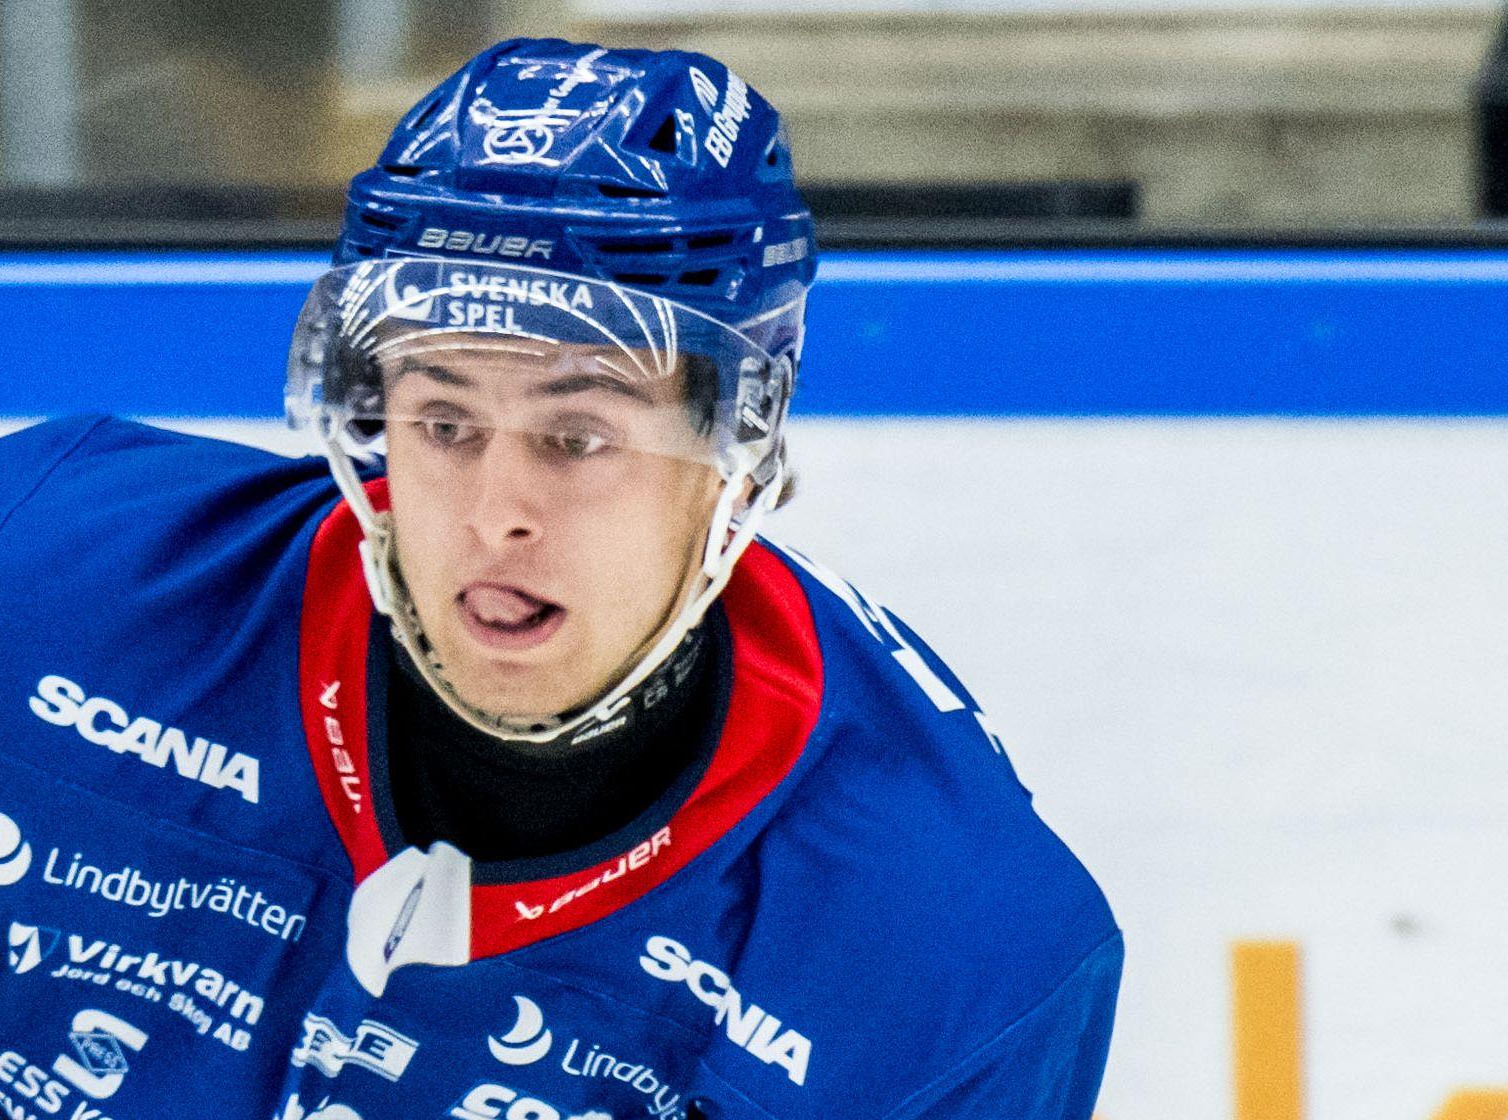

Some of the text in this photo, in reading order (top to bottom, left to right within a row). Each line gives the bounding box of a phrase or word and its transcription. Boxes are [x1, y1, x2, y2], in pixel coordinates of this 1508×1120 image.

[418, 228, 555, 259] BAUER
[447, 301, 523, 332] SPEL
[449, 272, 593, 309] SVENSKA
[28, 674, 261, 803] SCANIA
[42, 847, 307, 942] Lindbytvätten
[68, 934, 264, 1025] Virkvarn
[639, 935, 812, 1086] SCNIA
[213, 1022, 252, 1051] AB
